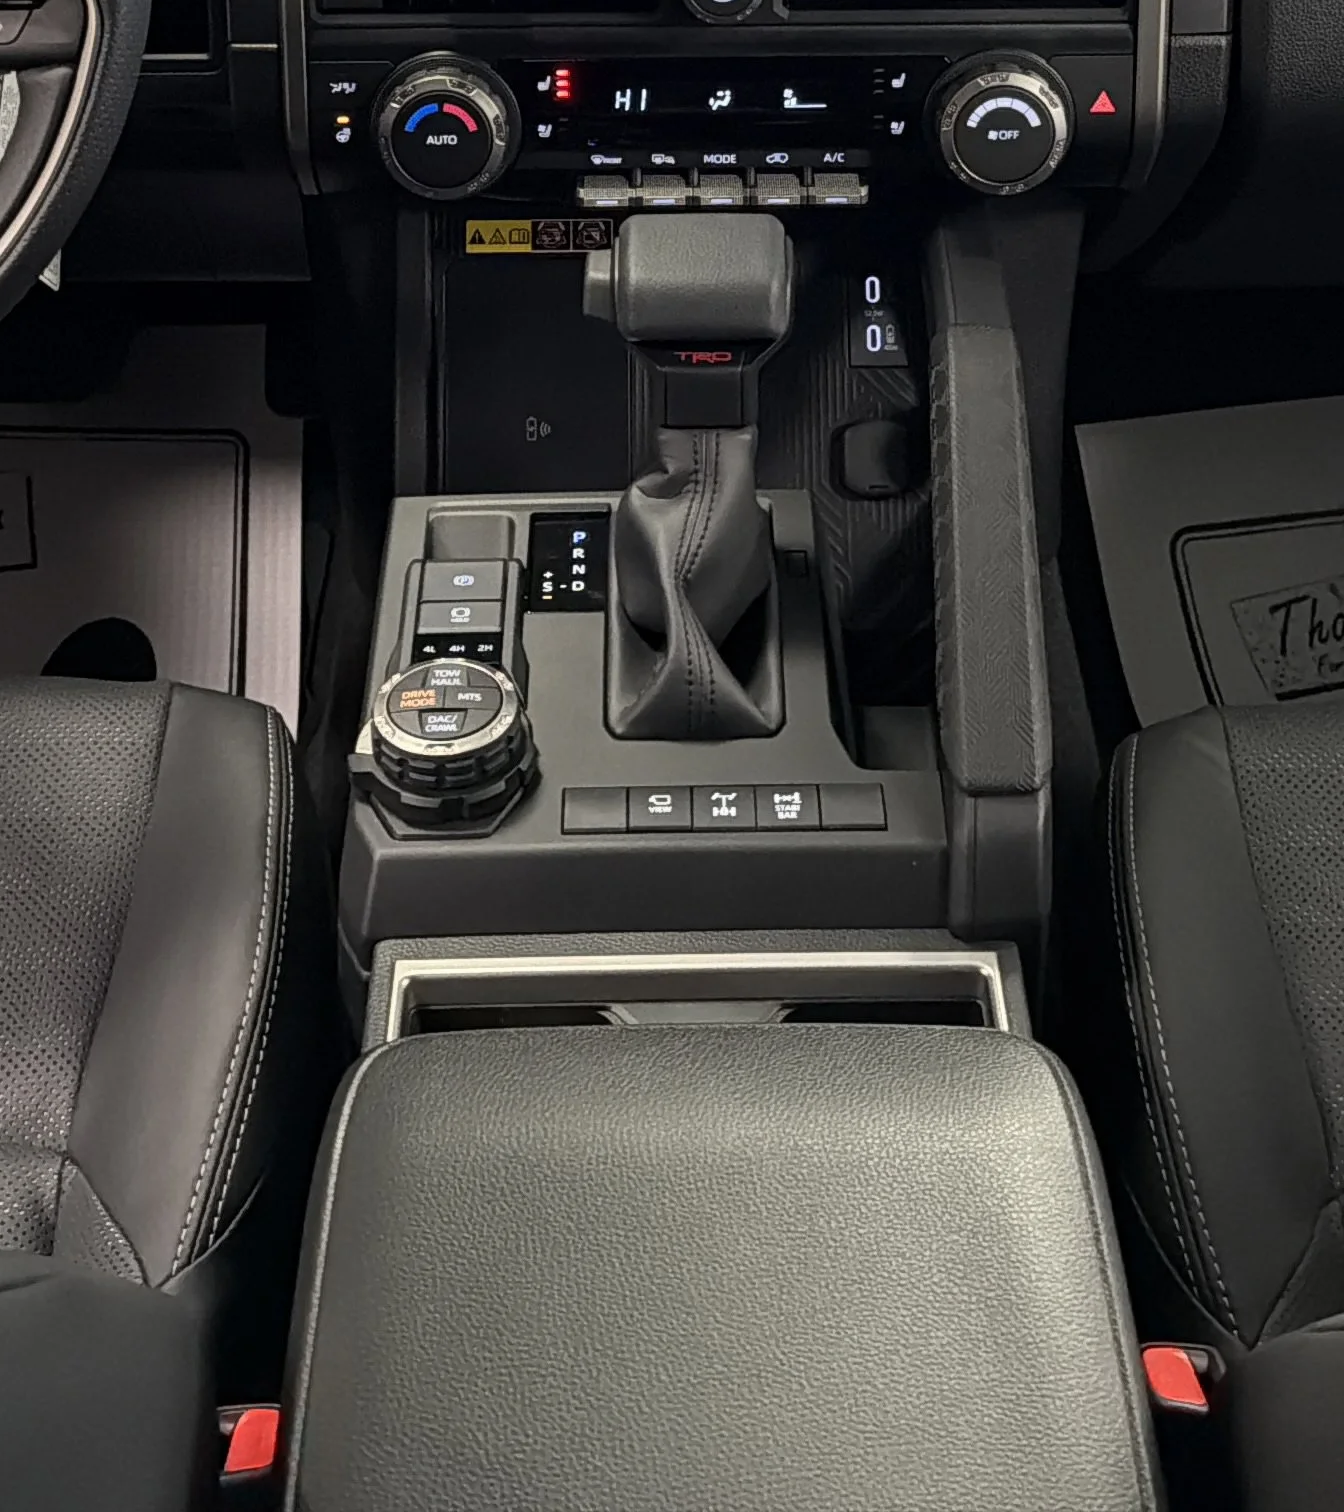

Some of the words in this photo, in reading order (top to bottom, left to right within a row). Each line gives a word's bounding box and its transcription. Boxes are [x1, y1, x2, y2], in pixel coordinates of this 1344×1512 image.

[614, 88, 648, 112] HI
[425, 134, 458, 146] AUTO
[998, 130, 1021, 141] OFF
[703, 153, 737, 164] MODE
[823, 151, 845, 164] A/C
[672, 351, 732, 365] TRD
[572, 531, 587, 544] P
[572, 547, 585, 559] R
[571, 564, 586, 575] N
[542, 581, 554, 592] S
[571, 580, 585, 592] D
[422, 645, 437, 654] 4L
[448, 644, 466, 653] 4H
[477, 643, 494, 652] 2H
[433, 669, 462, 678] TOW
[430, 677, 463, 686] HAUL
[401, 689, 437, 699] DRIVE
[457, 693, 483, 702] MTS
[399, 698, 437, 709] MODE
